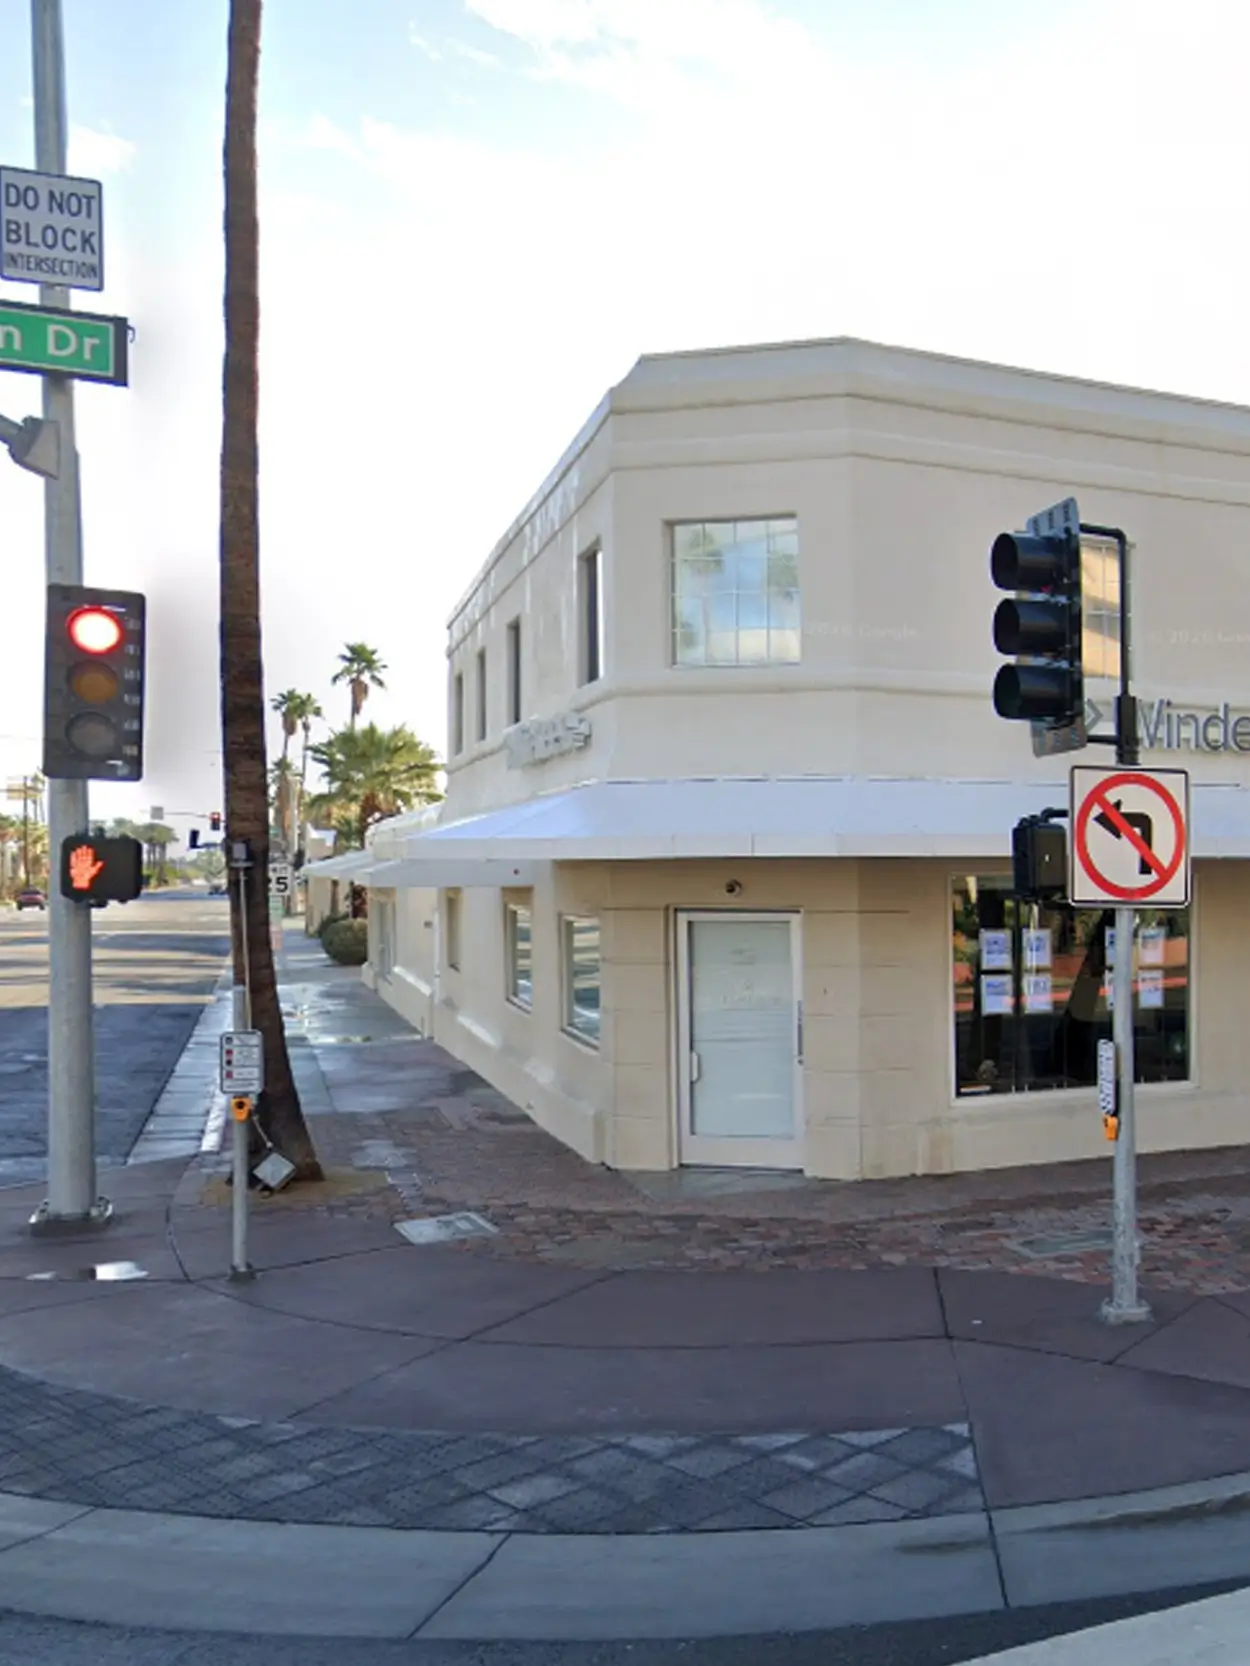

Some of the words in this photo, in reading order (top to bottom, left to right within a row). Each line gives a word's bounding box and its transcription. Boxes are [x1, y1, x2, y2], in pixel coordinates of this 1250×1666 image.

[5, 182, 39, 211] DO
[48, 188, 96, 219] NOT
[5, 219, 97, 256] BLOCK
[5, 252, 98, 279] INTERSECTION
[47, 323, 100, 361] Dr
